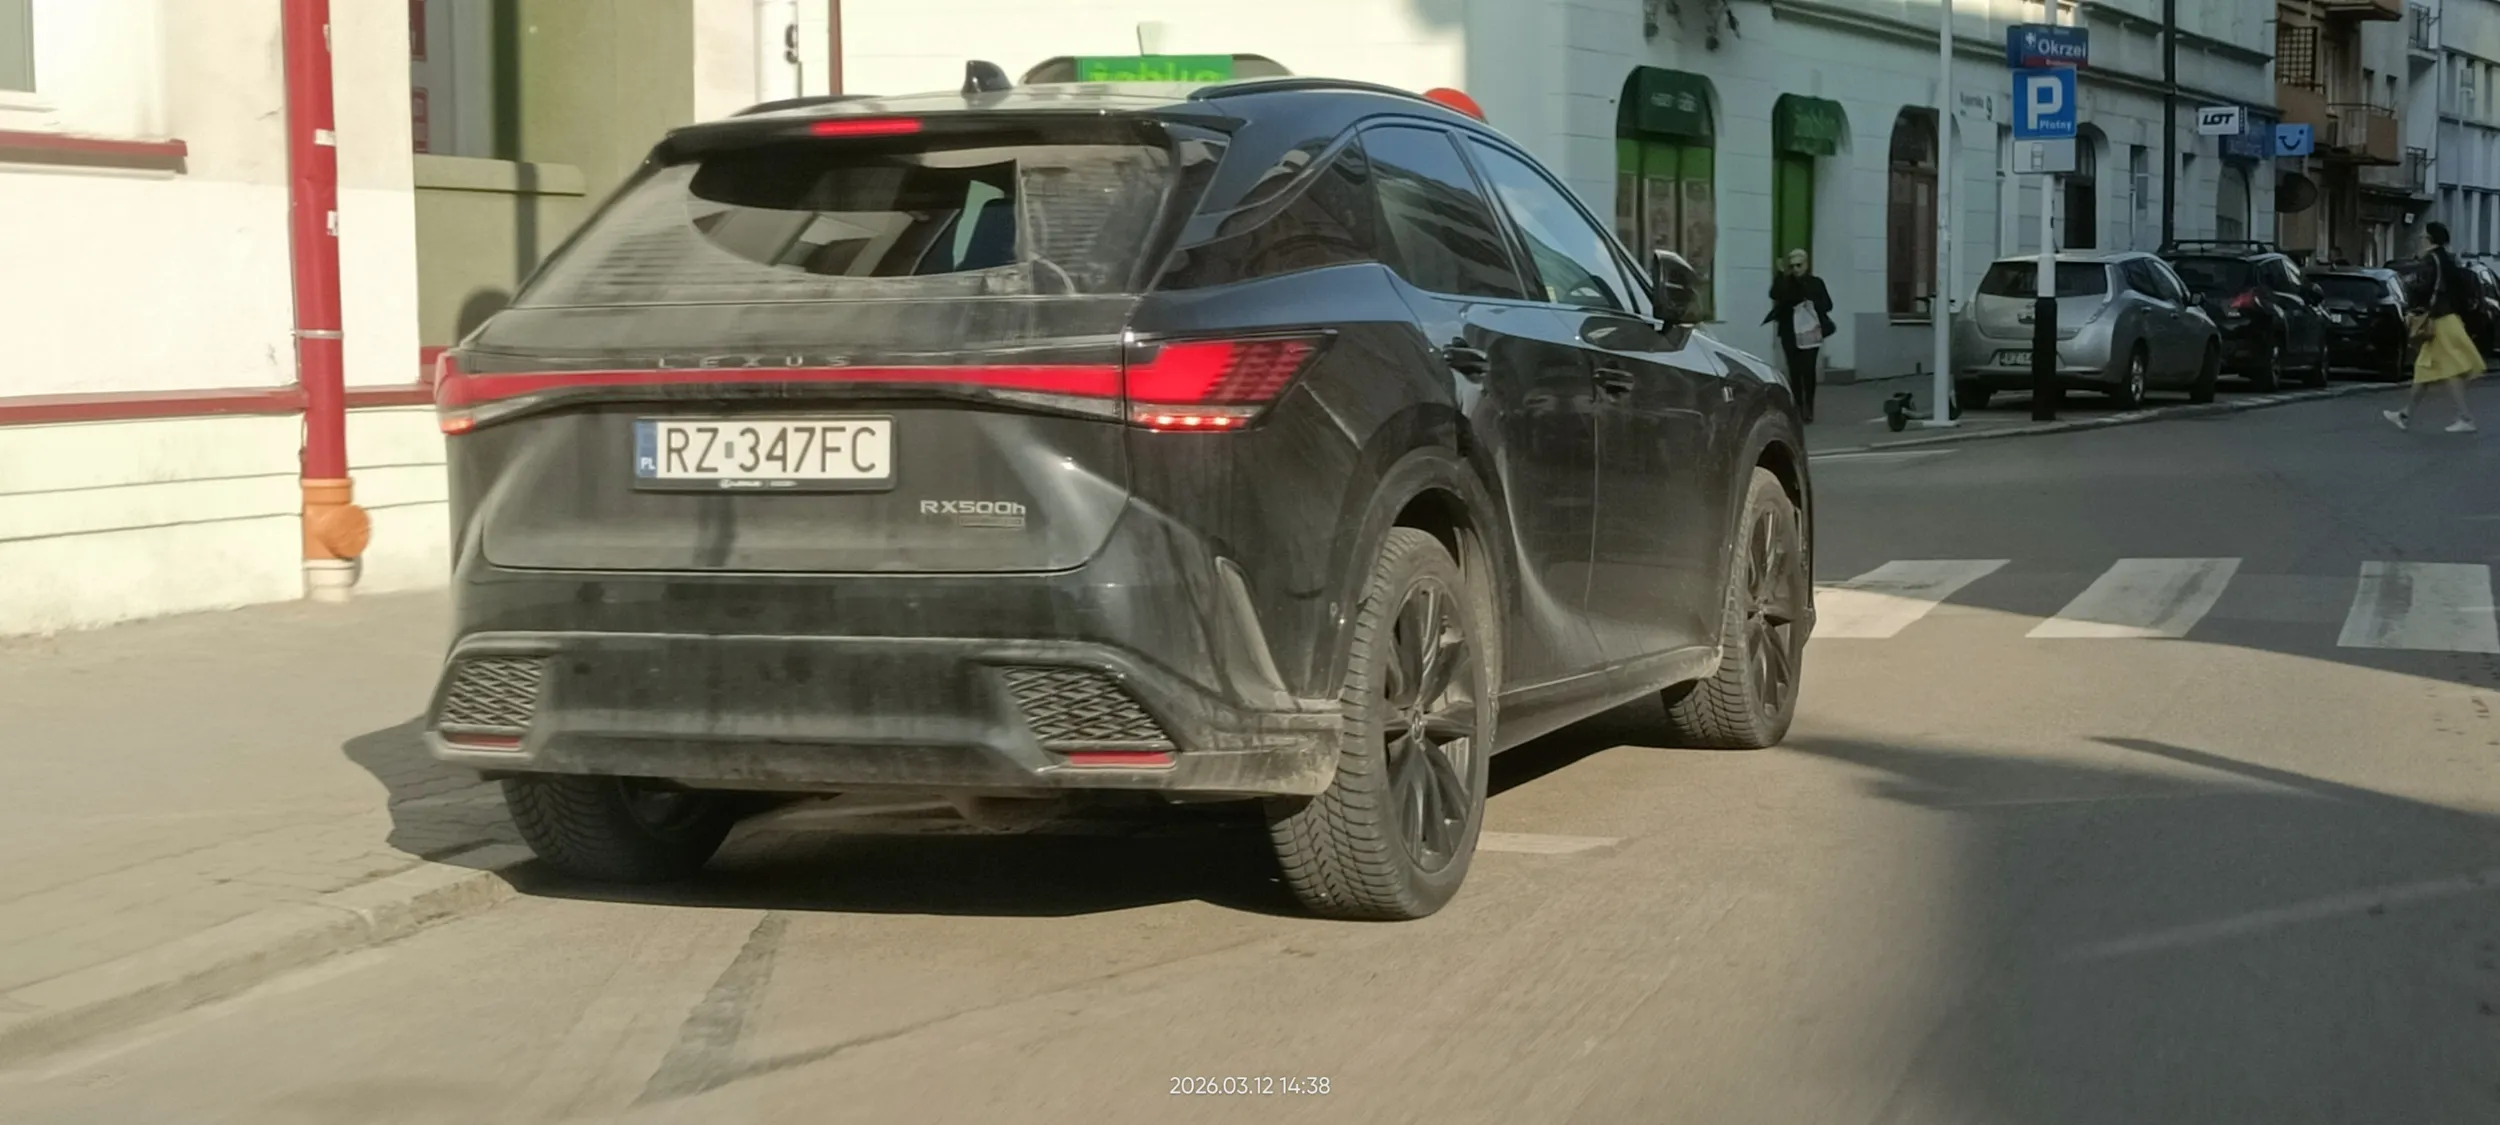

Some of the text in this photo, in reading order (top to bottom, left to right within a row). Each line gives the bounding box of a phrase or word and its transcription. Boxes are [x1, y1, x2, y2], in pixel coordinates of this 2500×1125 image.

[2038, 38, 2087, 58] Okrzei
[2027, 76, 2063, 131] P
[2202, 113, 2235, 126] LOT
[658, 355, 849, 369] LEXUS
[665, 425, 878, 474] RZ 347FC
[640, 456, 657, 471] PL
[920, 499, 1027, 516] RX500h
